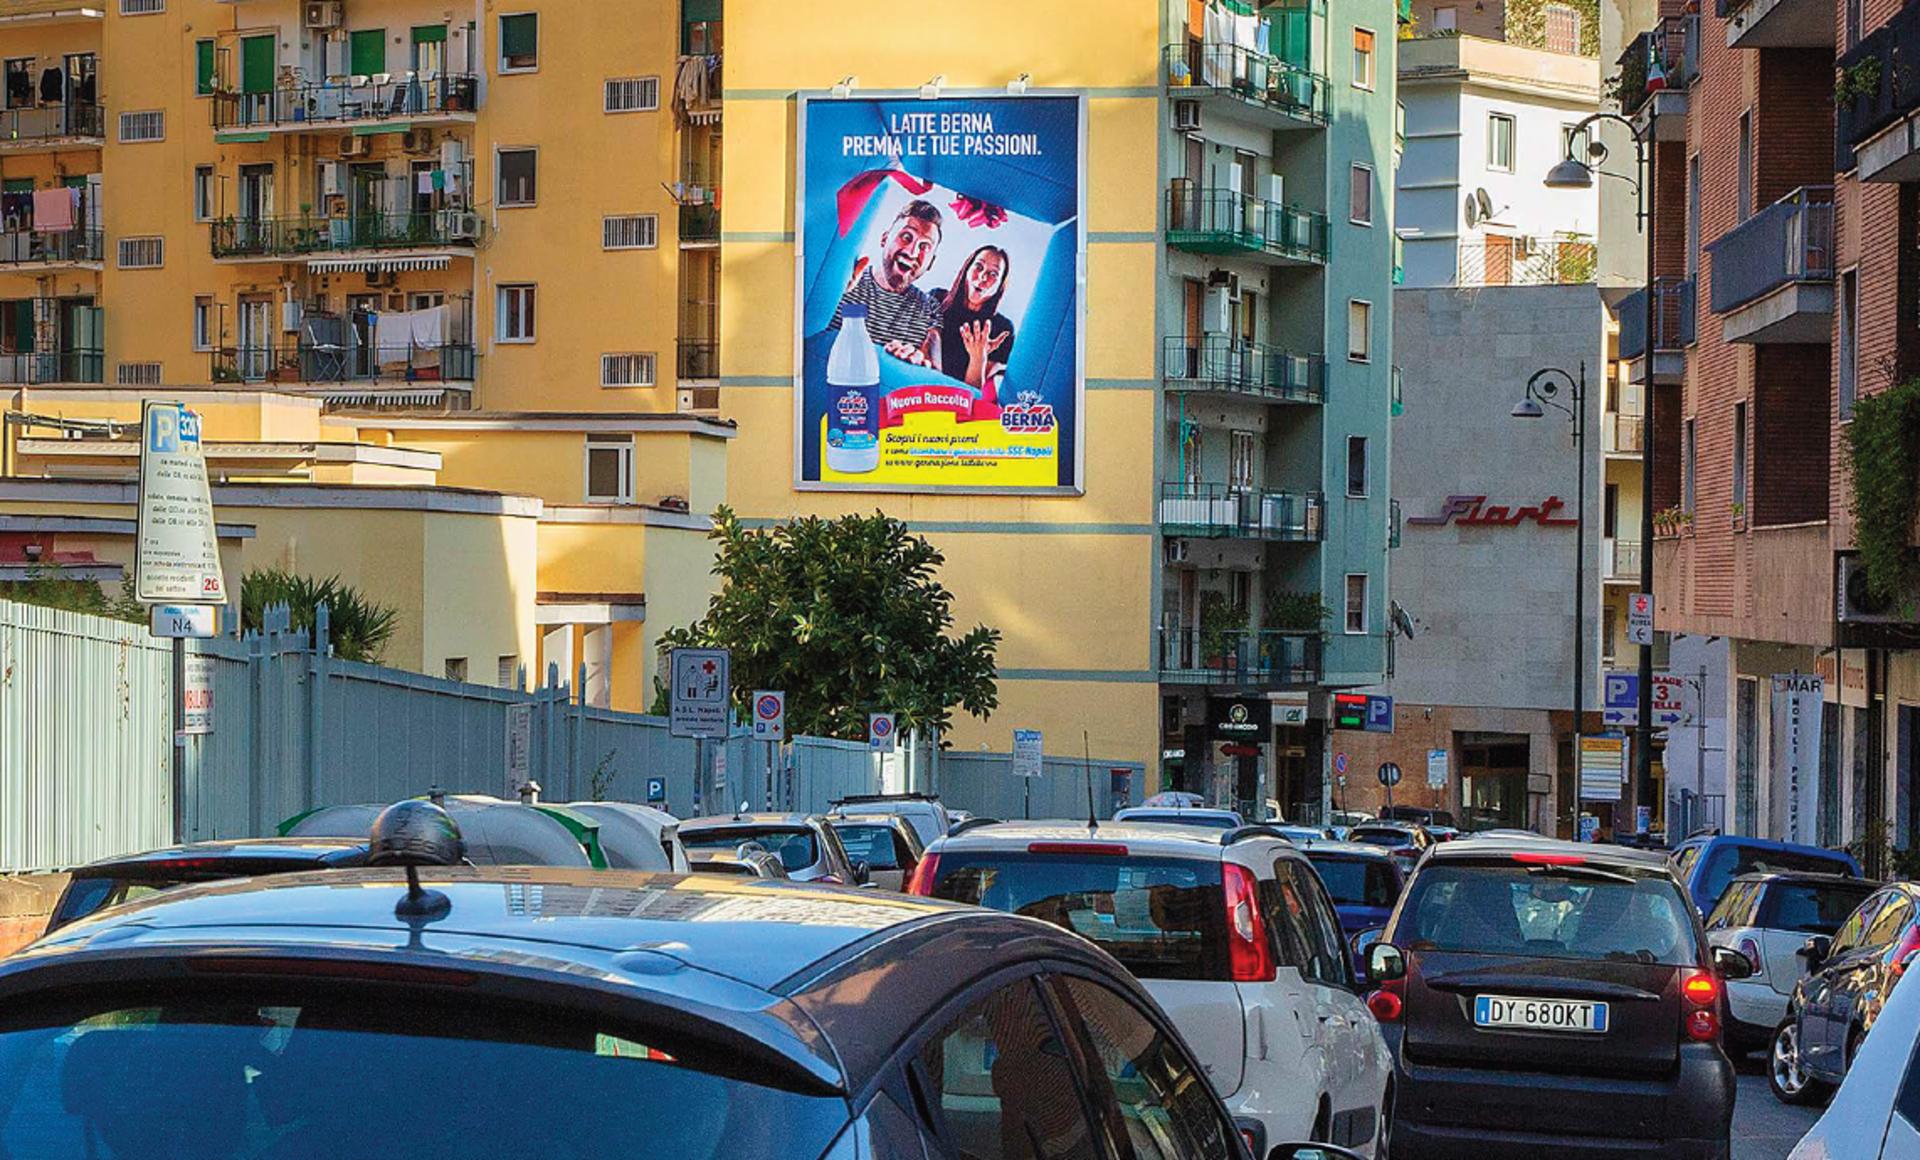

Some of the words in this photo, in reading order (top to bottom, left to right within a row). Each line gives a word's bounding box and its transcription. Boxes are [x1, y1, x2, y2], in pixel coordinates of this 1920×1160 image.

[891, 113, 936, 134] LATTE
[941, 112, 994, 134] BERNA
[842, 136, 903, 157] PREMIA
[907, 135, 927, 156] LE
[931, 135, 960, 156] TUE
[964, 134, 1042, 156] PASSIONI.
[890, 395, 922, 410] Nuova
[924, 392, 970, 408] Raccolta
[1001, 412, 1055, 427] BERNA
[885, 433, 915, 446] Scopri
[923, 433, 949, 444] nuovi
[1007, 446, 1024, 456] SSC
[1025, 446, 1053, 457] Napoli
[172, 618, 193, 633] N4
[1608, 679, 1628, 703] P
[1656, 685, 1669, 700] 3
[1786, 680, 1822, 693] MAR
[1791, 697, 1800, 754] MOBILI
[649, 781, 662, 797] P
[1491, 1001, 1516, 1022] DY
[1525, 1003, 1592, 1027] 680KT
